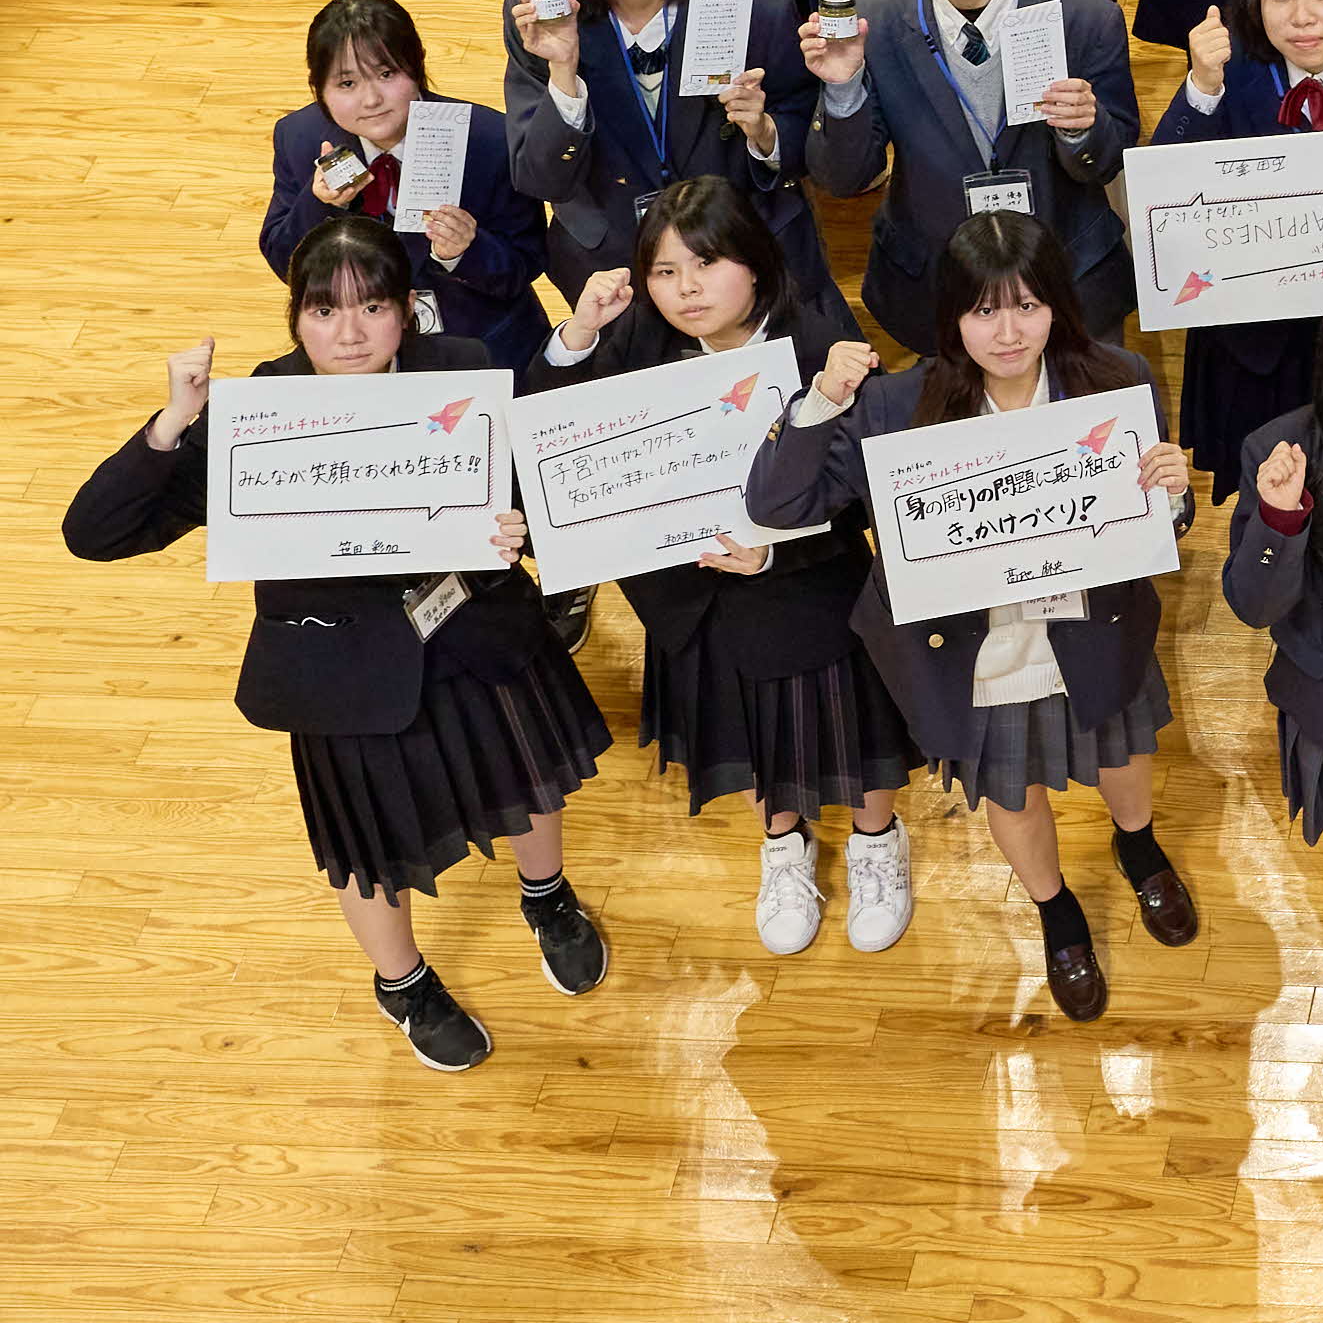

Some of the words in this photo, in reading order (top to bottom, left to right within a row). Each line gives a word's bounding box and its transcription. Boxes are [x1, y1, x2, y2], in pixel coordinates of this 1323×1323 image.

[232, 412, 357, 439] スペシャルチャレンジ
[535, 408, 651, 455] スペシャルチャレンジ
[238, 453, 483, 487] みんなが笑顔でおくれる生活を!!
[891, 449, 1008, 492] スペシャルチャレンジ
[904, 450, 1127, 522] 身の周りの問題に取り組む
